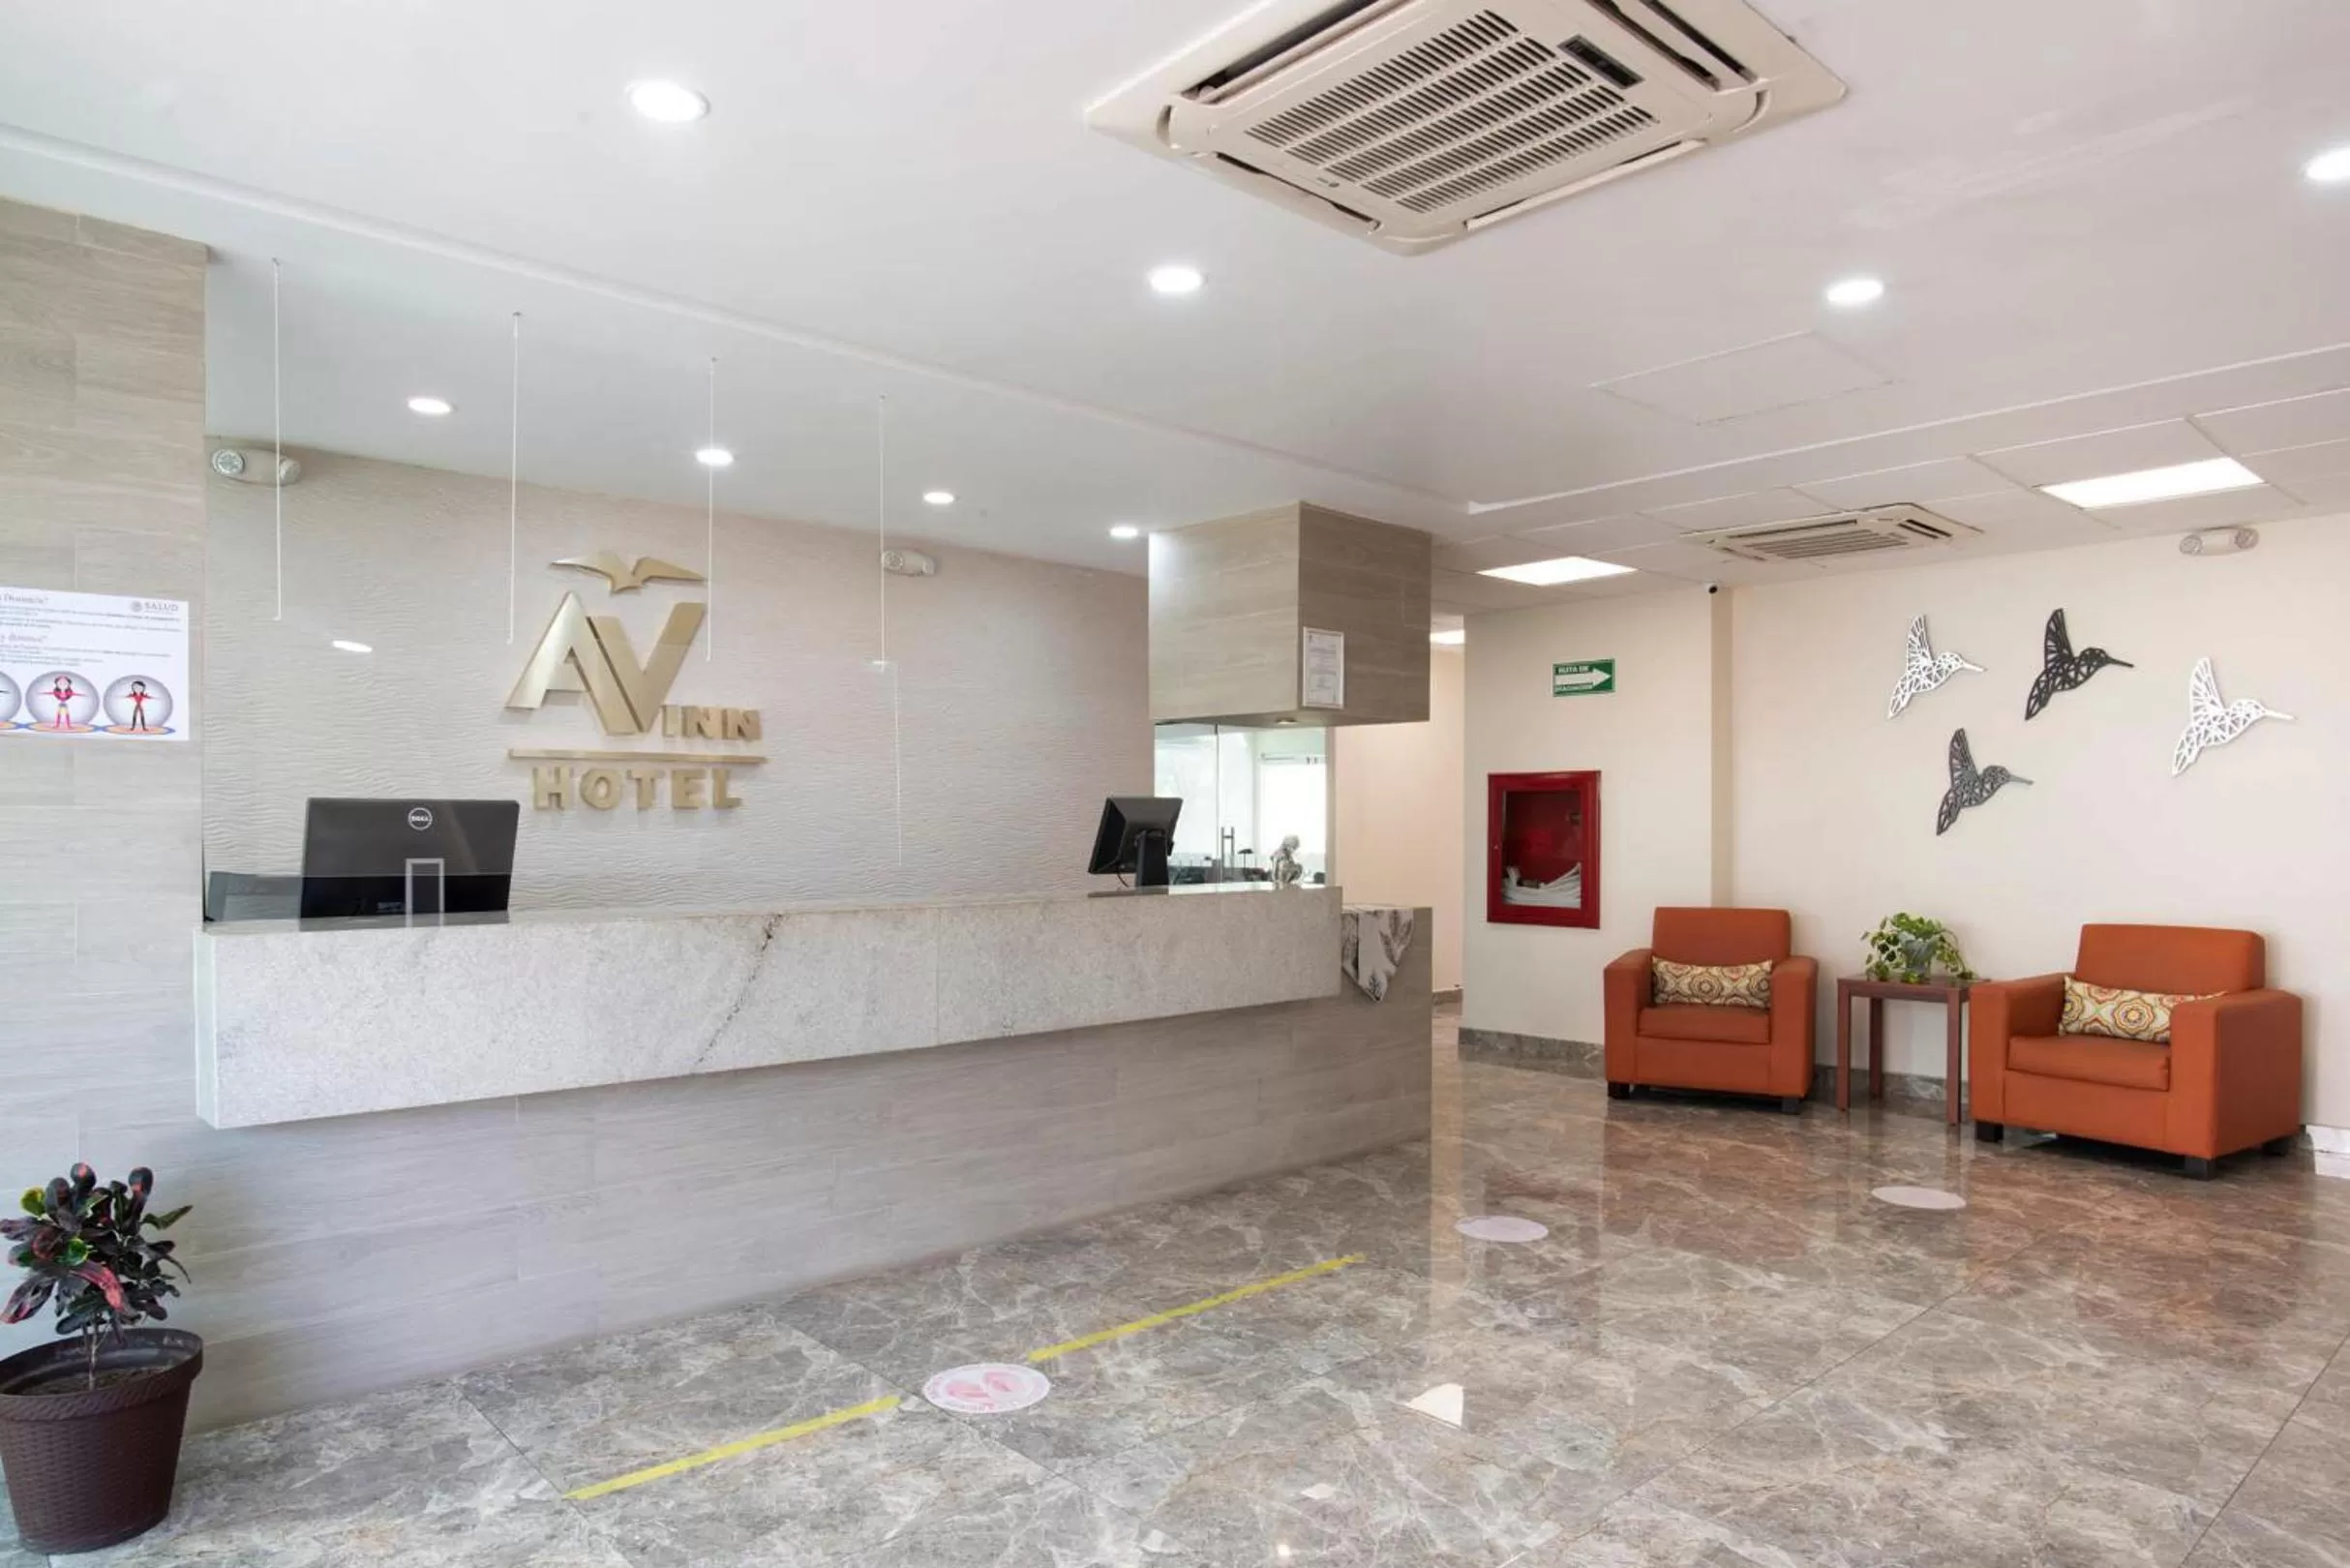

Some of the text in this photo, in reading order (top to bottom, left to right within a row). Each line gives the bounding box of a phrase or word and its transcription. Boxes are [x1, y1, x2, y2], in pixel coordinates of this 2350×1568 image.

[503, 590, 762, 740] AV INN
[532, 766, 743, 811] HOTEL
